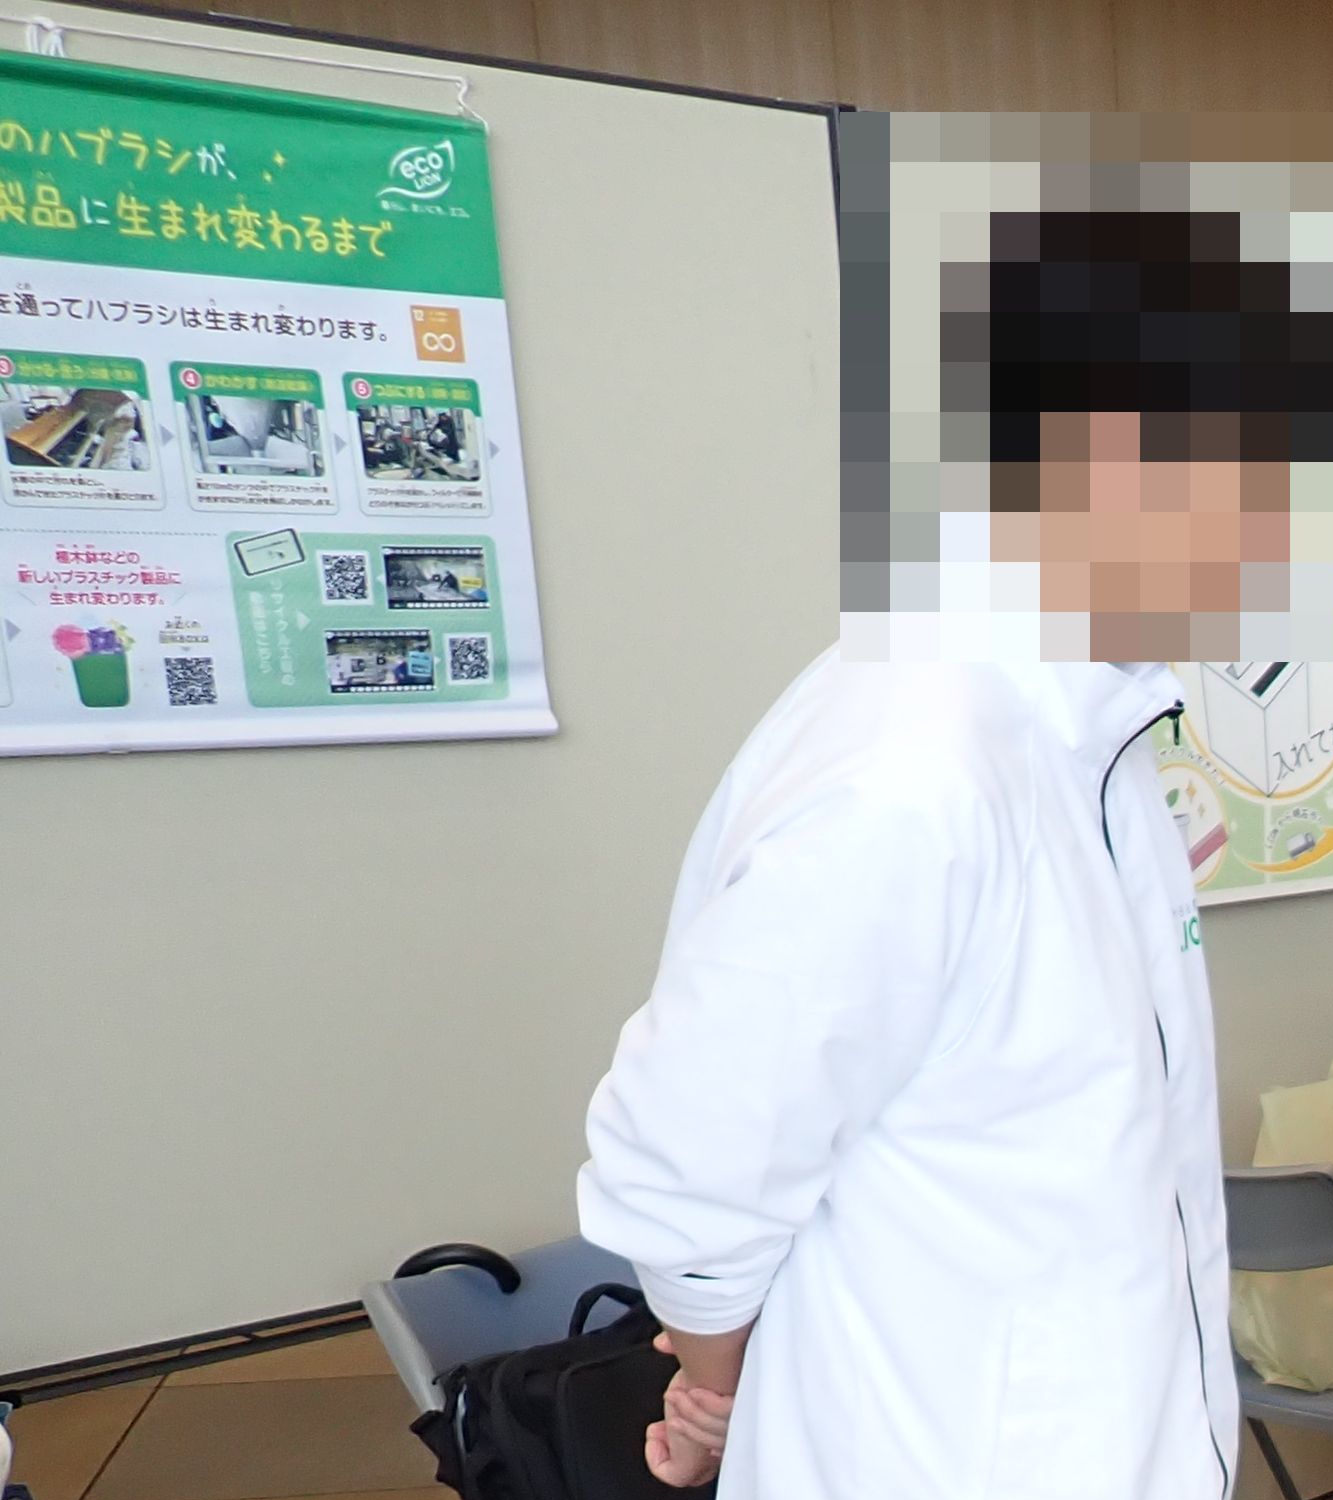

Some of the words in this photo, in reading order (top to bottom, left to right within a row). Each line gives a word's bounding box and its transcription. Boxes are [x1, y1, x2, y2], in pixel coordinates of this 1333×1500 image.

[400, 151, 444, 179] eco
[413, 171, 443, 191] LION
[18, 569, 182, 586] 新しいプラスチック製品に
[49, 591, 165, 606] 生まれ変わります。
